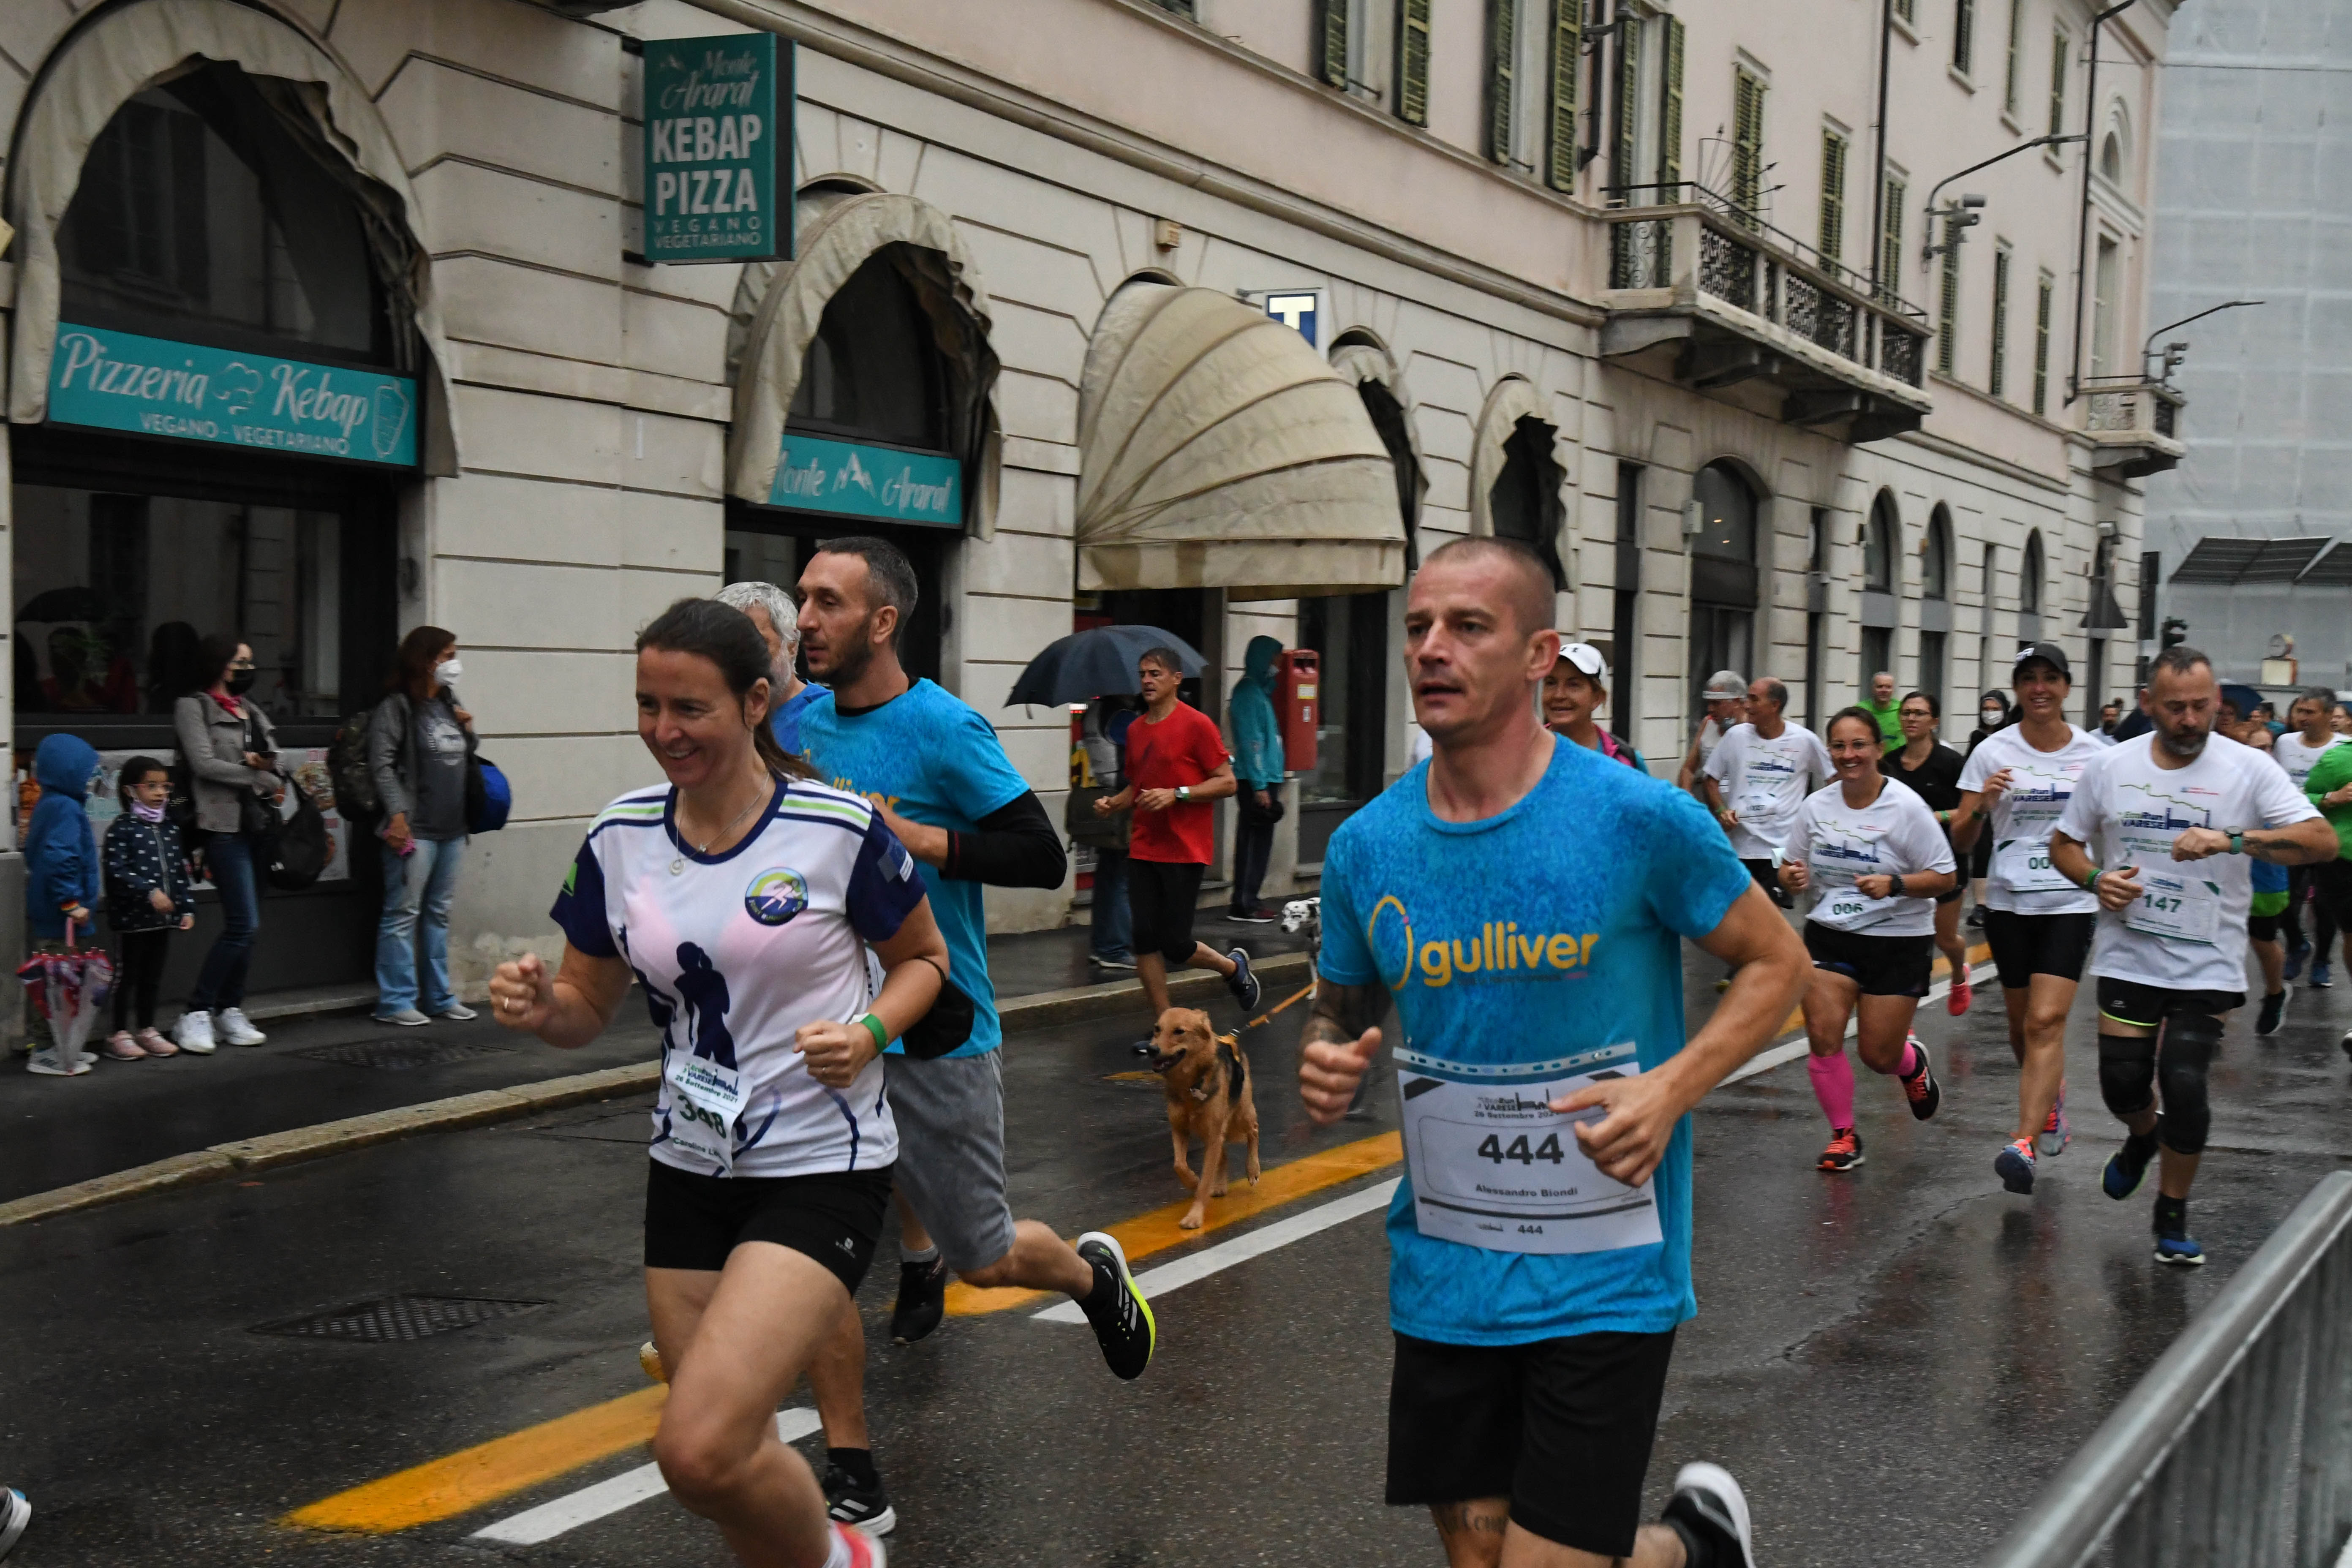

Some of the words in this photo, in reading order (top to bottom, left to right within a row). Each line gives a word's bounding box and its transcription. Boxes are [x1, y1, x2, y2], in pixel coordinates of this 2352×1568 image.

[651, 114, 762, 163] KEBAP
[655, 169, 757, 216] PIZZA
[653, 216, 762, 234] VEGANO
[653, 231, 762, 248] VEGETARIANO
[1269, 296, 1315, 330] T
[59, 334, 210, 410] Pizzeria
[271, 364, 369, 438] Kebap
[139, 413, 219, 439] VEGANO
[233, 424, 351, 455] VEGETARIANO
[2143, 894, 2182, 913] 147
[1420, 922, 1599, 988] gulliver
[1478, 1132, 1564, 1165] 444
[1476, 1184, 1537, 1197] Alessandro
[1541, 1187, 1578, 1197] Biondi
[1517, 1224, 1544, 1234] 444
